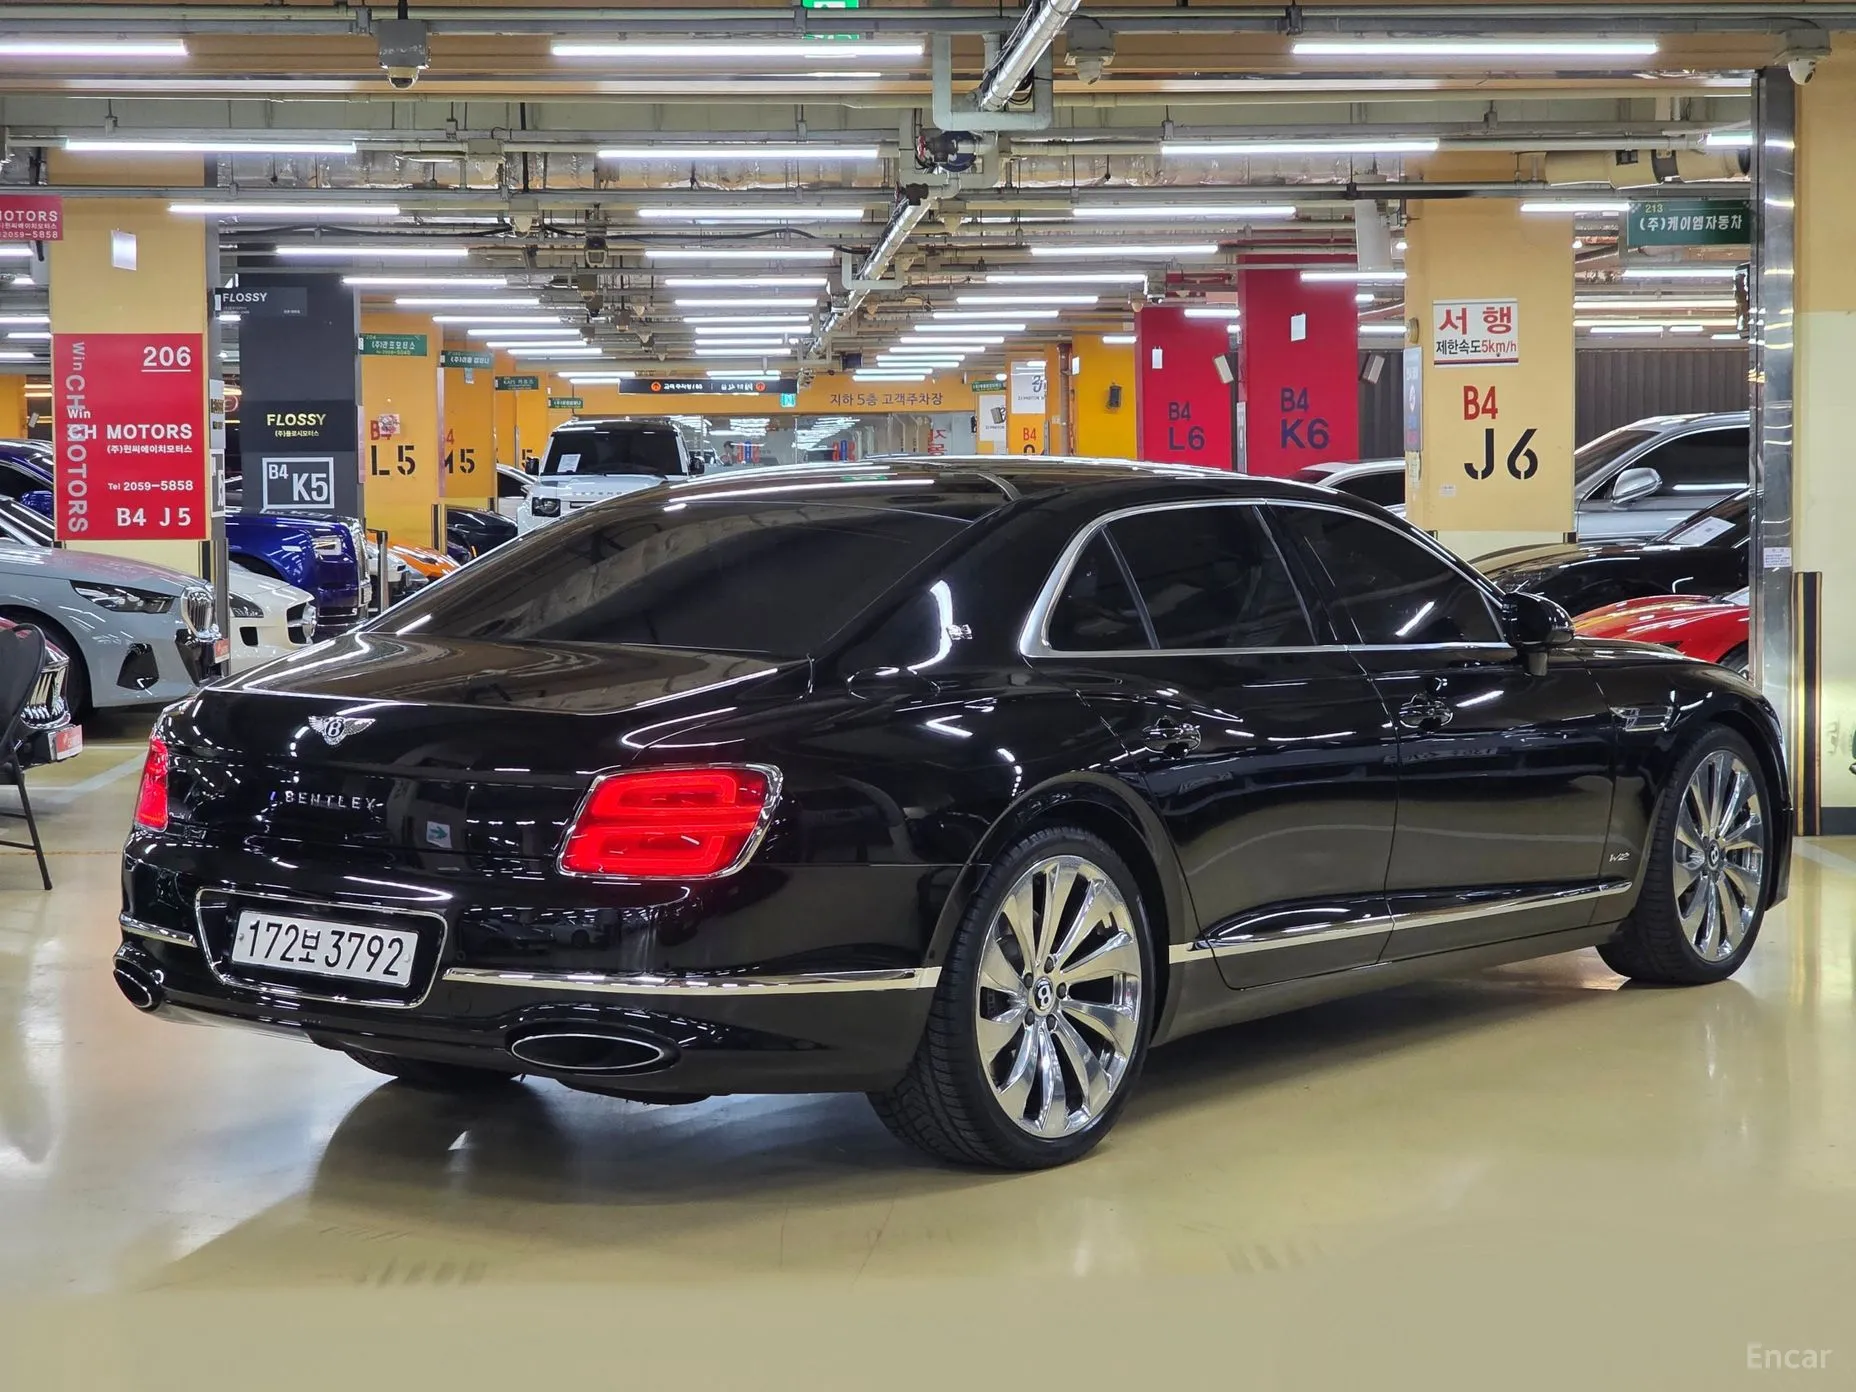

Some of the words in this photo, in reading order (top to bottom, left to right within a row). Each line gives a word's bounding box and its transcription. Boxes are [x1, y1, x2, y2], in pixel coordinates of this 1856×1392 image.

[1645, 203, 1663, 213] 213
[222, 292, 268, 303] FLOSSY
[143, 346, 192, 367] 206
[830, 393, 854, 406] 지하
[857, 393, 878, 406] 5층
[881, 392, 943, 406] 고객주차장
[1280, 387, 1309, 412] B4
[1463, 385, 1498, 420] B4
[68, 408, 91, 419] Win
[266, 413, 326, 426] FLOSSY
[1168, 401, 1191, 421] B4
[106, 424, 193, 440] MOTORS
[1023, 428, 1037, 441] B4
[1168, 426, 1205, 451] L6
[1280, 418, 1329, 450] K6
[371, 445, 416, 476] L5
[268, 464, 289, 480] B4
[123, 480, 194, 491] 2059-5858
[292, 473, 329, 502] K5
[116, 507, 147, 527] B4
[284, 790, 376, 811] BENTLEY
